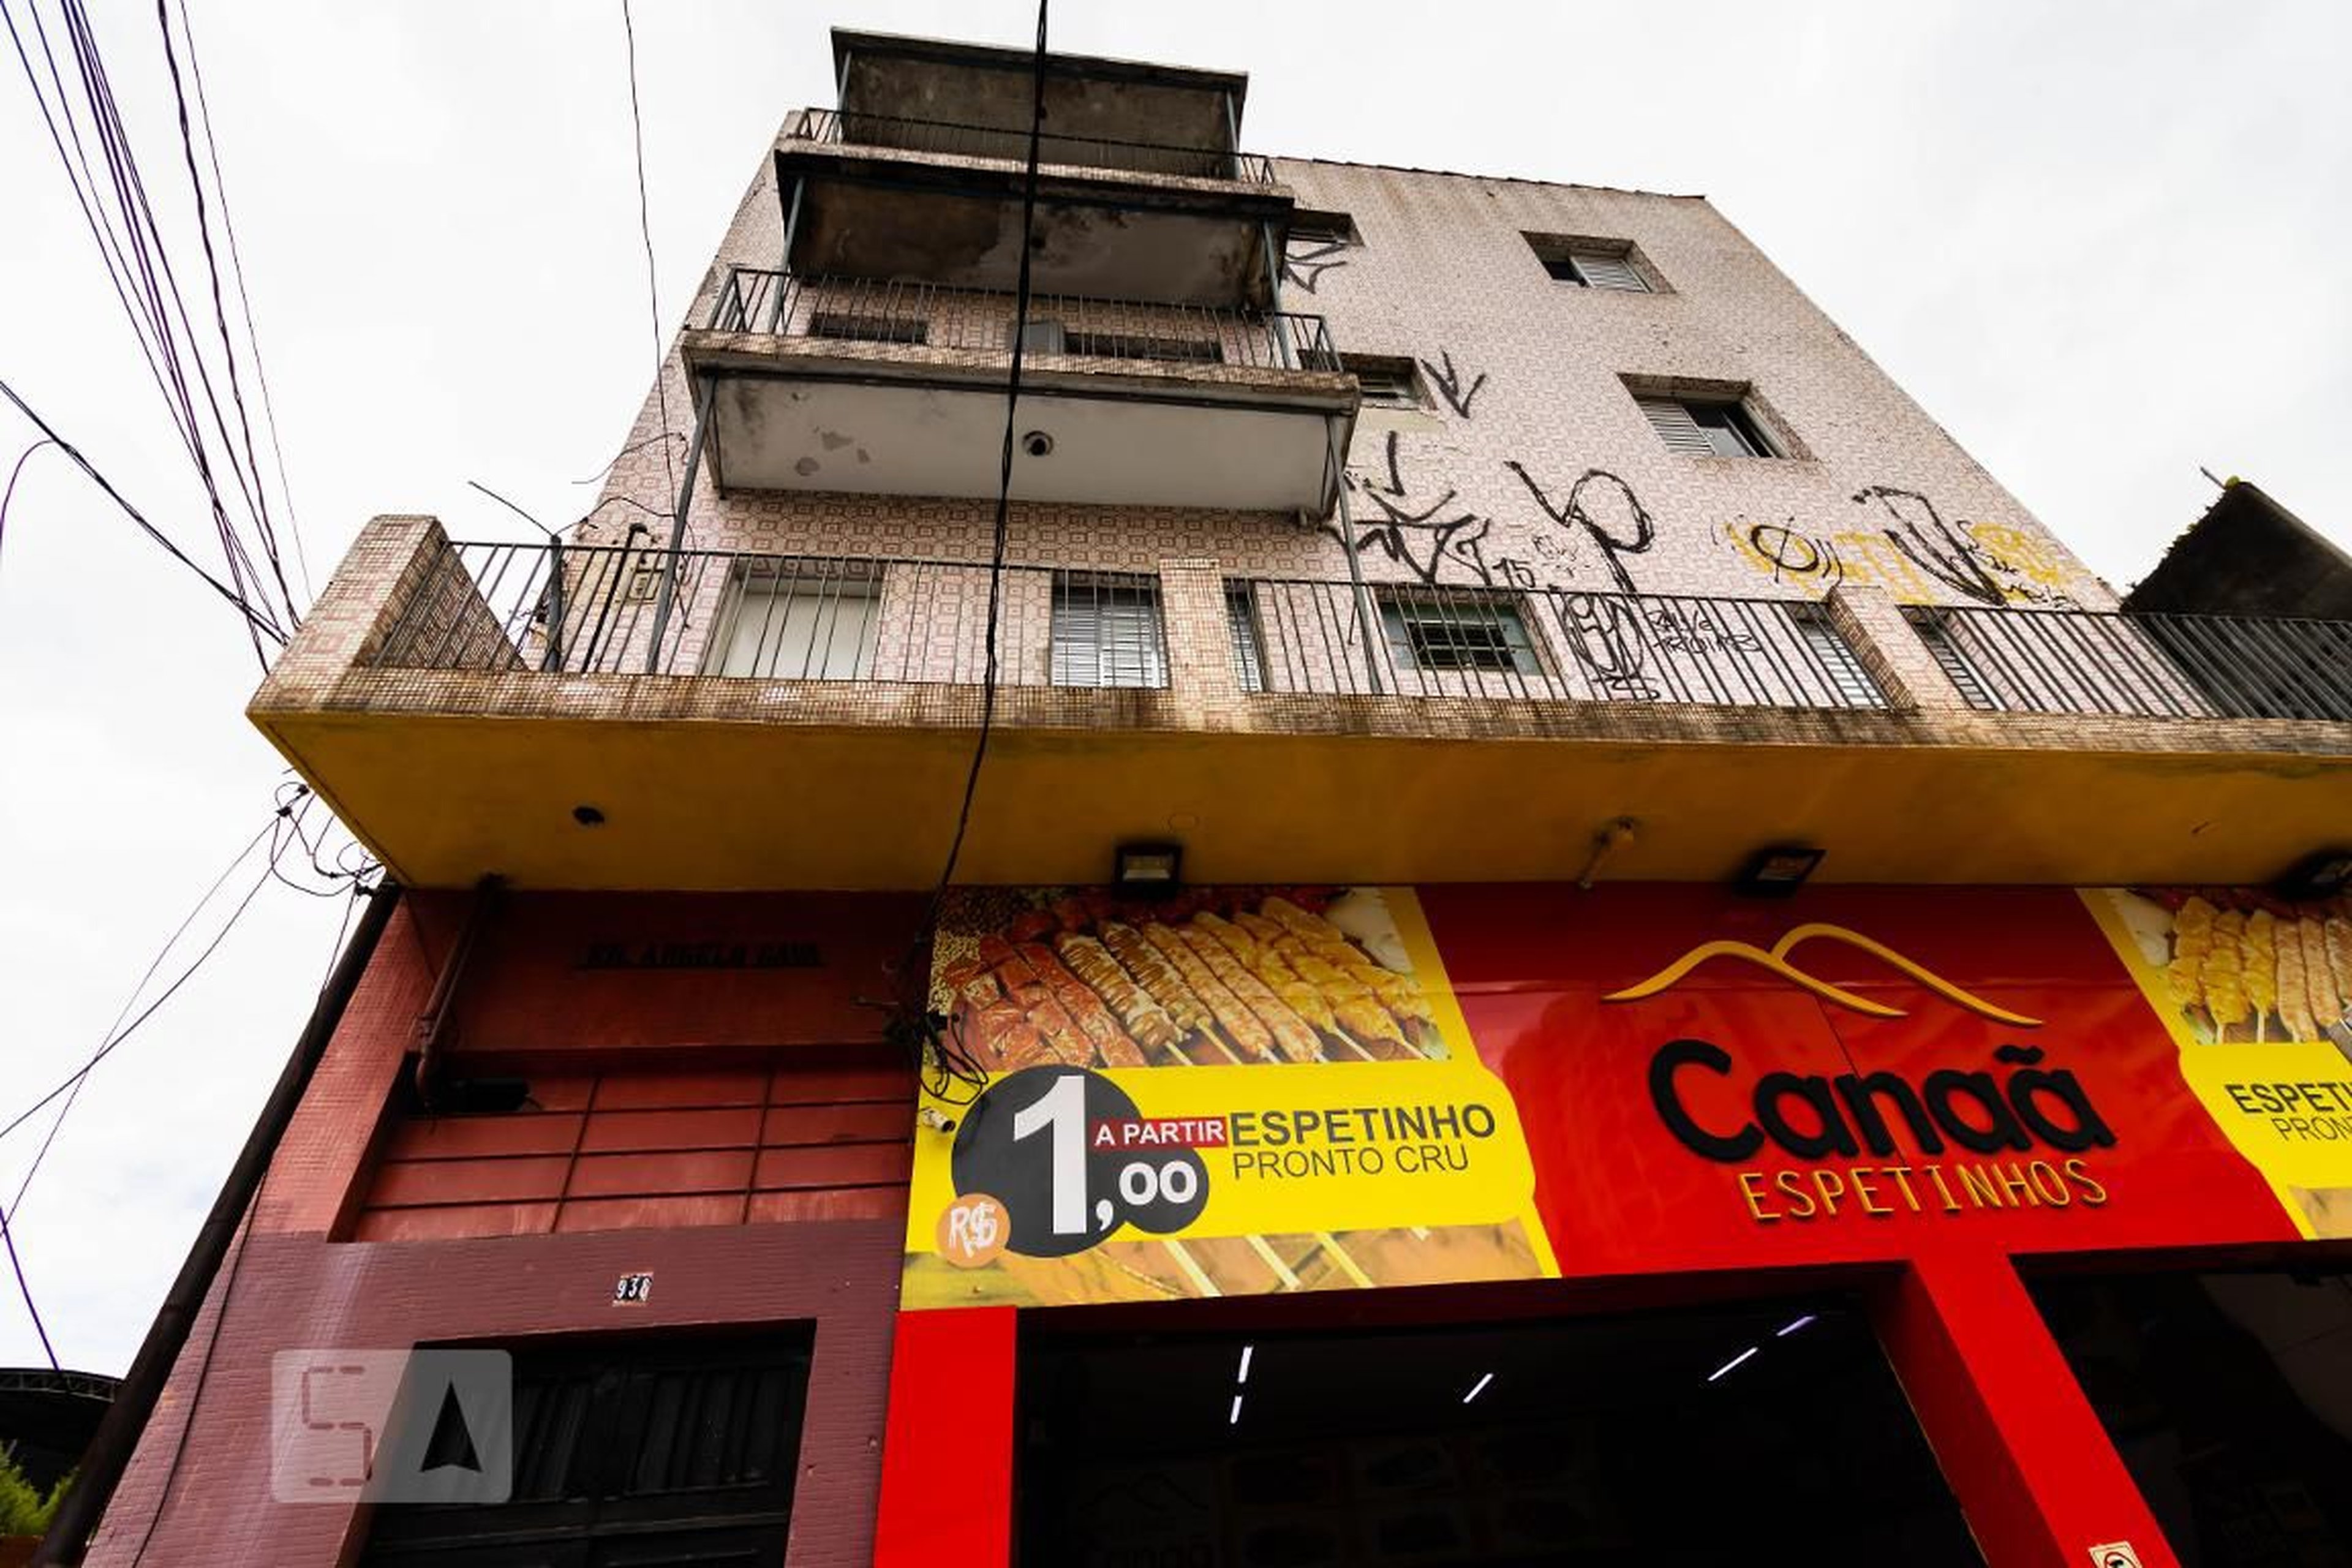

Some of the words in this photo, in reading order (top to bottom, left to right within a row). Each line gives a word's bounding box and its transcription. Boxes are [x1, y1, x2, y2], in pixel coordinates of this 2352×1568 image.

[1649, 1040, 2116, 1164] Canaã
[1095, 1125, 1115, 1145] A
[1124, 1120, 1224, 1144] PARTIR
[1231, 1104, 1495, 1146] ESPETINHO
[1232, 1147, 1384, 1179] PRONTO
[1395, 1144, 1469, 1174] CRU
[1738, 1159, 2108, 1220] ESPETINHOS
